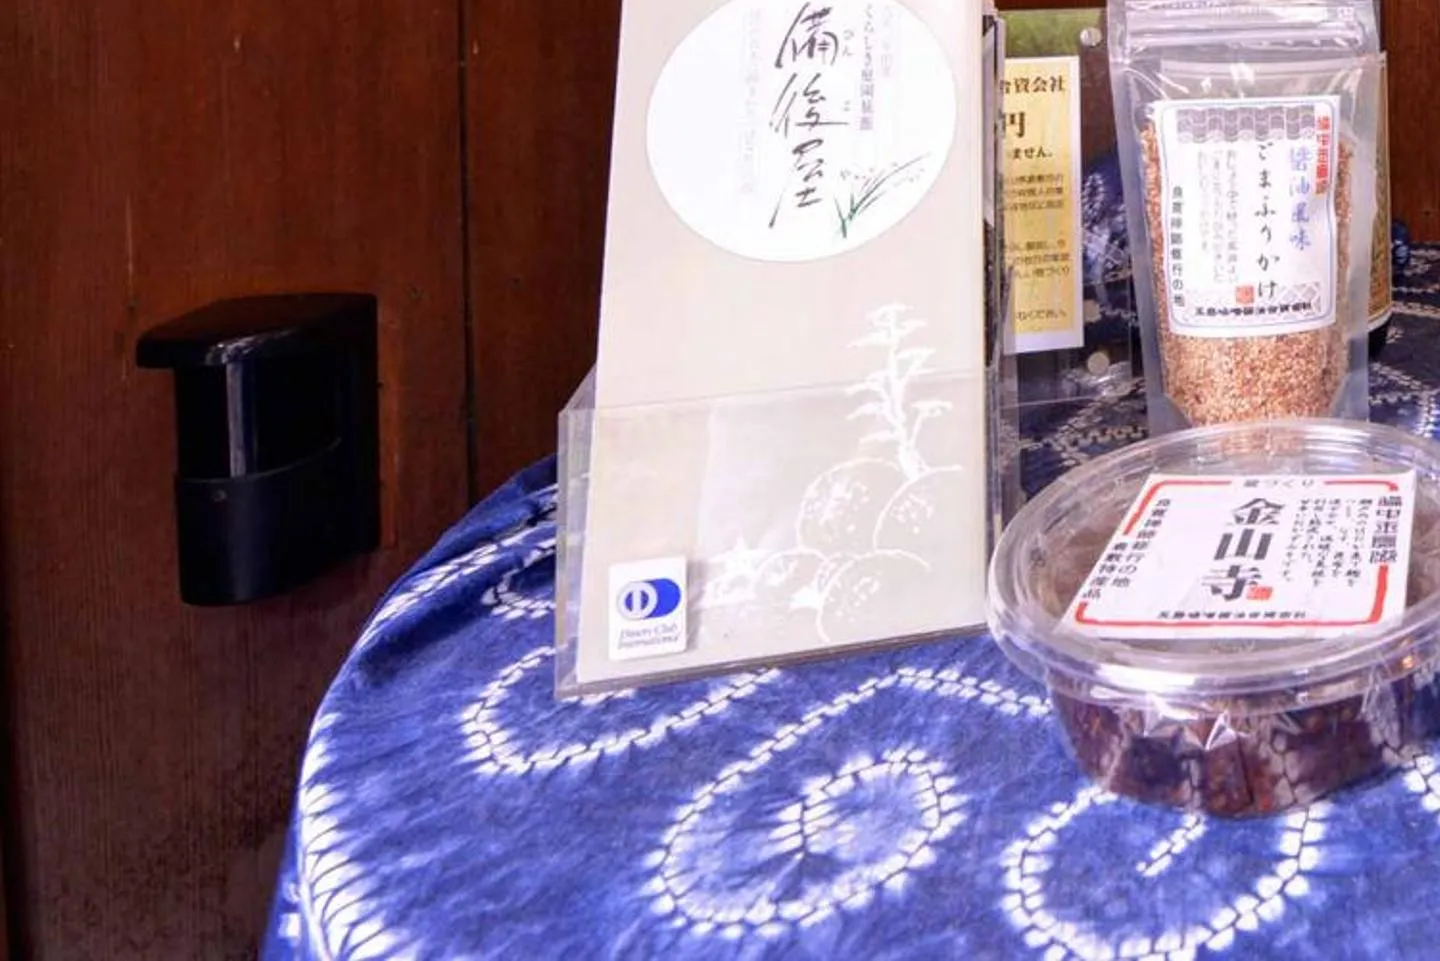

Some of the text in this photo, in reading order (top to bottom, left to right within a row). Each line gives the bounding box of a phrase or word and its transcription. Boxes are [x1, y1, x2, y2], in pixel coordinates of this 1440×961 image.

[1255, 141, 1281, 300] ごまふりかけ
[1201, 497, 1286, 601] 金山寺
